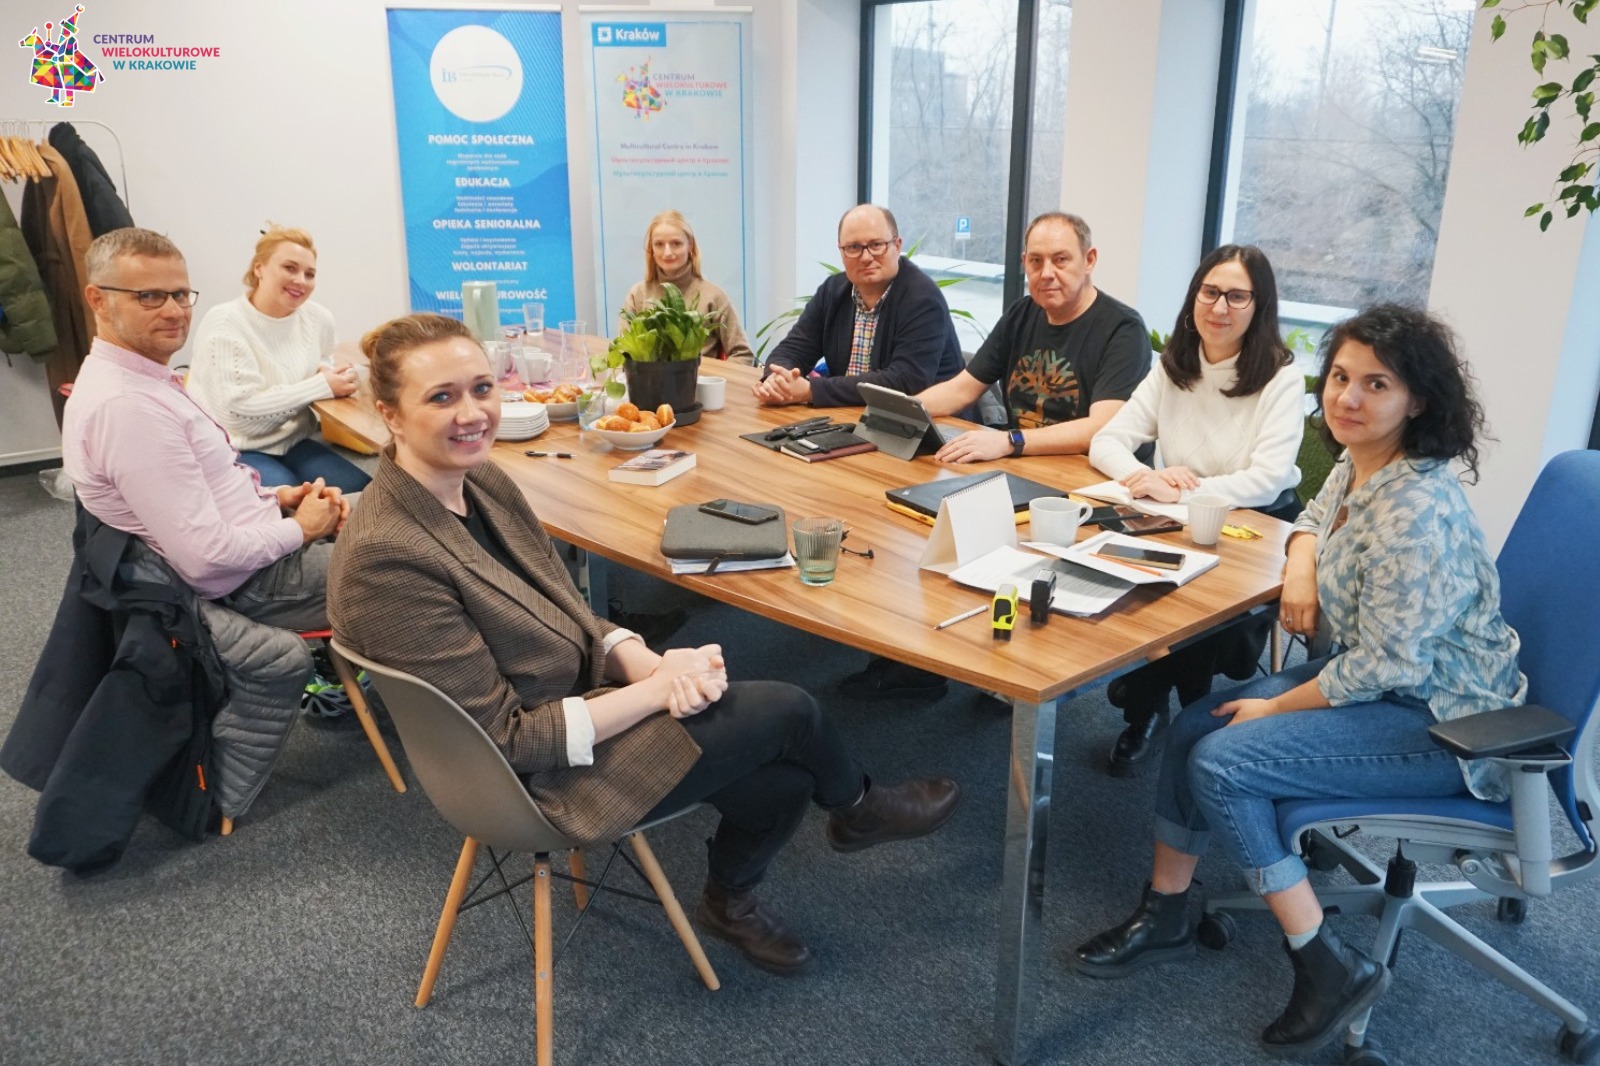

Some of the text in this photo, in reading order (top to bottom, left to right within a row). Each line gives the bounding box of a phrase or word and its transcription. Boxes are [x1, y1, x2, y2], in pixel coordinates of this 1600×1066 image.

[615, 28, 660, 41] Kraków
[653, 73, 695, 81] CENTRUM
[657, 81, 728, 89] WIELOKULTUROWE
[664, 89, 723, 97] W KRAKOWIE
[428, 135, 534, 145] POMOC SPOŁECZNA
[455, 177, 511, 188] EDUKACJA
[432, 219, 541, 229] OPIEKA SENIORALNA
[959, 218, 968, 231] P
[451, 261, 528, 271] WOLONTARIAT
